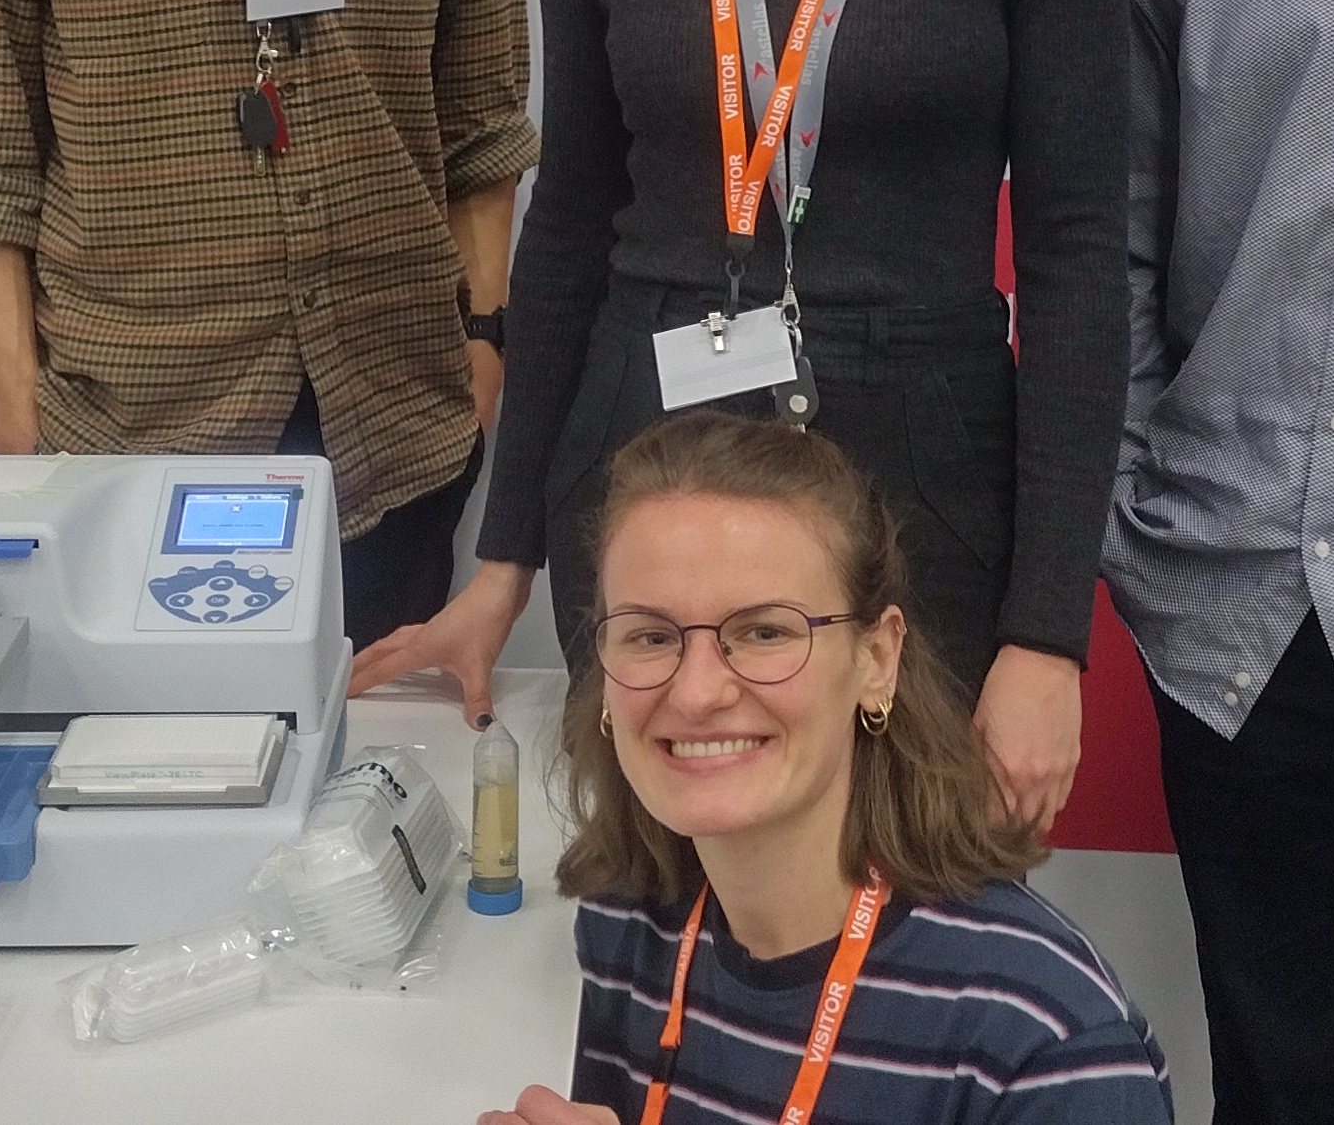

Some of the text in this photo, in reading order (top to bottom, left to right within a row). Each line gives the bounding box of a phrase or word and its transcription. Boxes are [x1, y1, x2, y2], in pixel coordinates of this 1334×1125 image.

[751, 2, 772, 59] astellas
[800, 26, 823, 87] astellas
[720, 53, 740, 121] VISITOR
[760, 85, 794, 149] VISITOR
[737, 180, 762, 233] VISITO
[265, 473, 306, 482] Thermo
[210, 597, 226, 605] OK
[807, 980, 847, 1065] VISITOR
